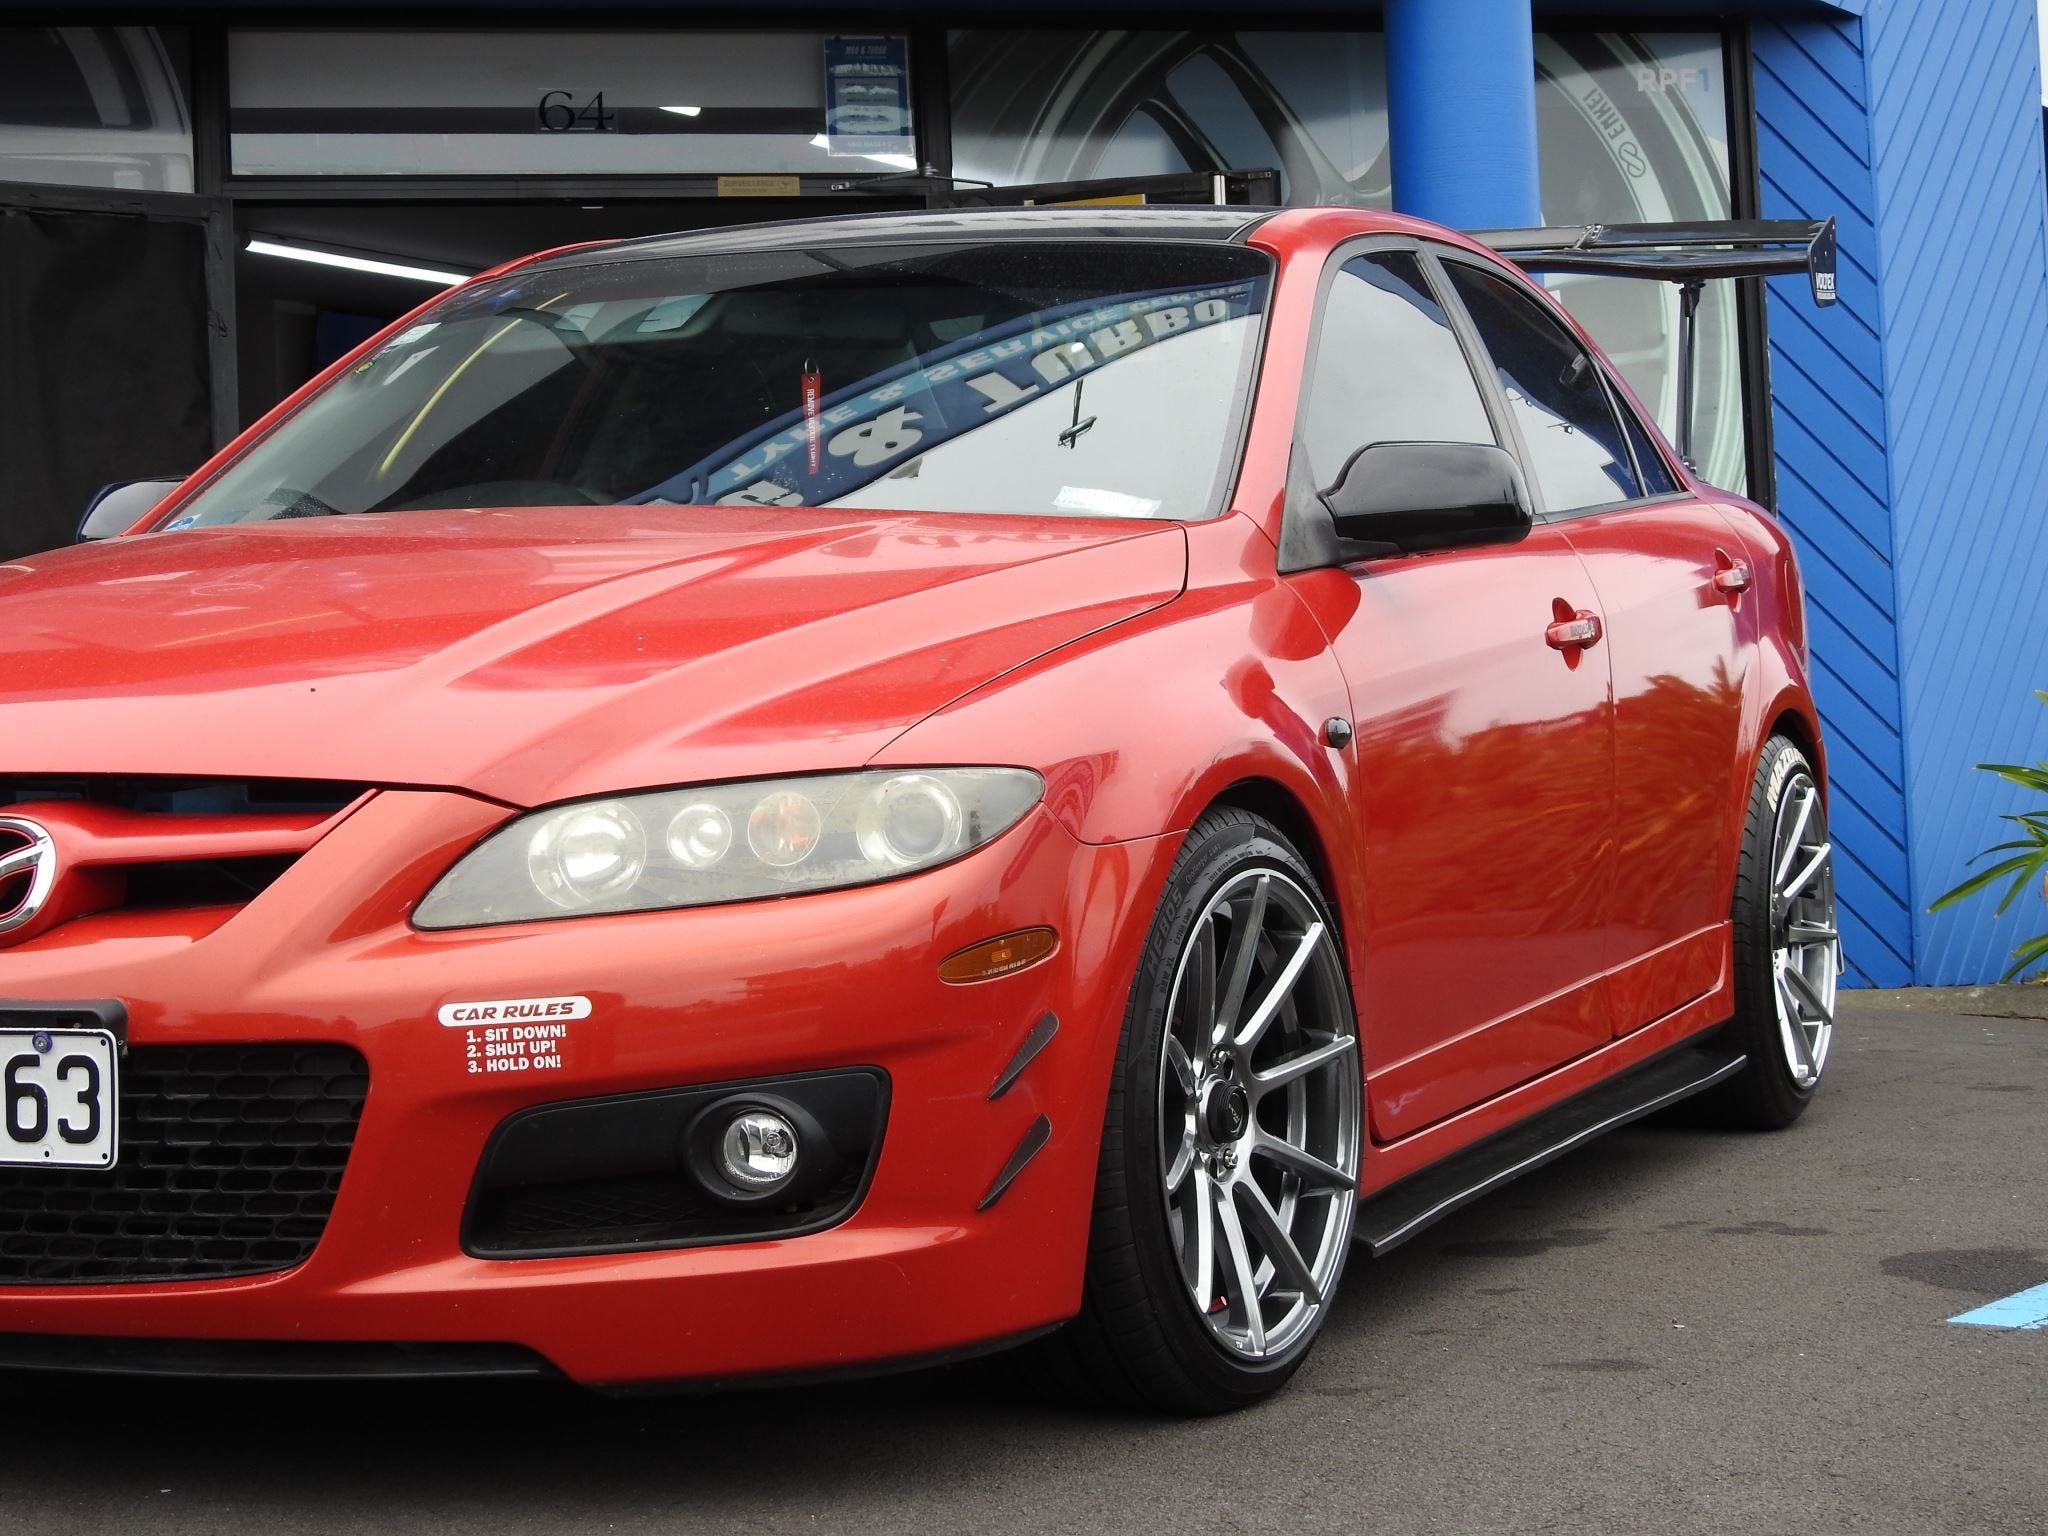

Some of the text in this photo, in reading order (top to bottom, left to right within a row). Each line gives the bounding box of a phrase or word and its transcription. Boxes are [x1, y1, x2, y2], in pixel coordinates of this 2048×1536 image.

[1637, 68, 1709, 92] RPF1
[539, 91, 615, 131] 64
[1583, 88, 1625, 140] ENKEI
[806, 388, 815, 417] REMOVE
[452, 1002, 575, 1021] CAR RULES
[466, 1024, 567, 1043] 1. SIT DOWN!
[466, 1039, 556, 1058] 2. SHUT UP!
[467, 1055, 562, 1073] 3. HOLD ON!
[4, 1054, 101, 1144] 63
